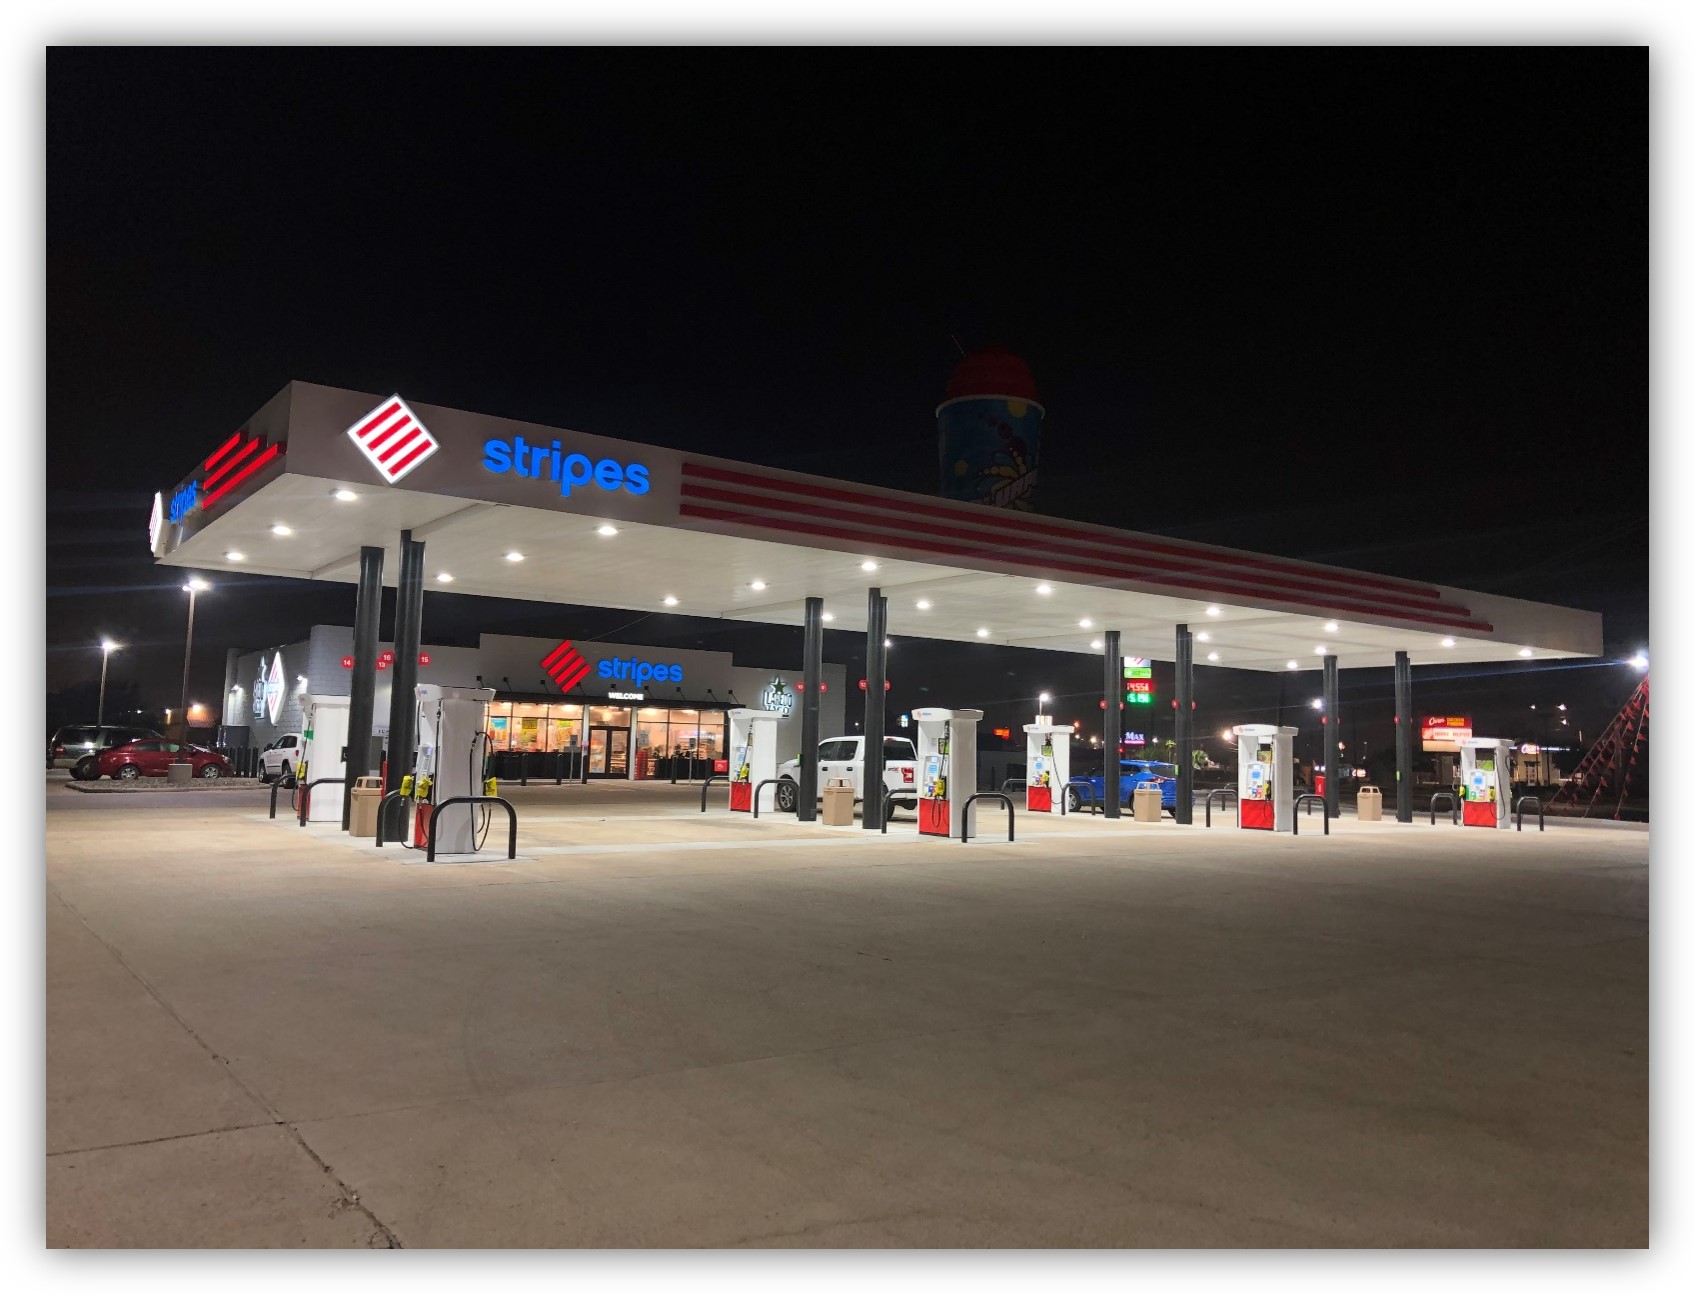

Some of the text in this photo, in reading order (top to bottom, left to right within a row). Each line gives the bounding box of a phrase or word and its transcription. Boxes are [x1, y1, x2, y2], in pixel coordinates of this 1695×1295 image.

[482, 436, 650, 497] stripes
[598, 656, 683, 687] stripes
[608, 691, 645, 701] WELCOME
